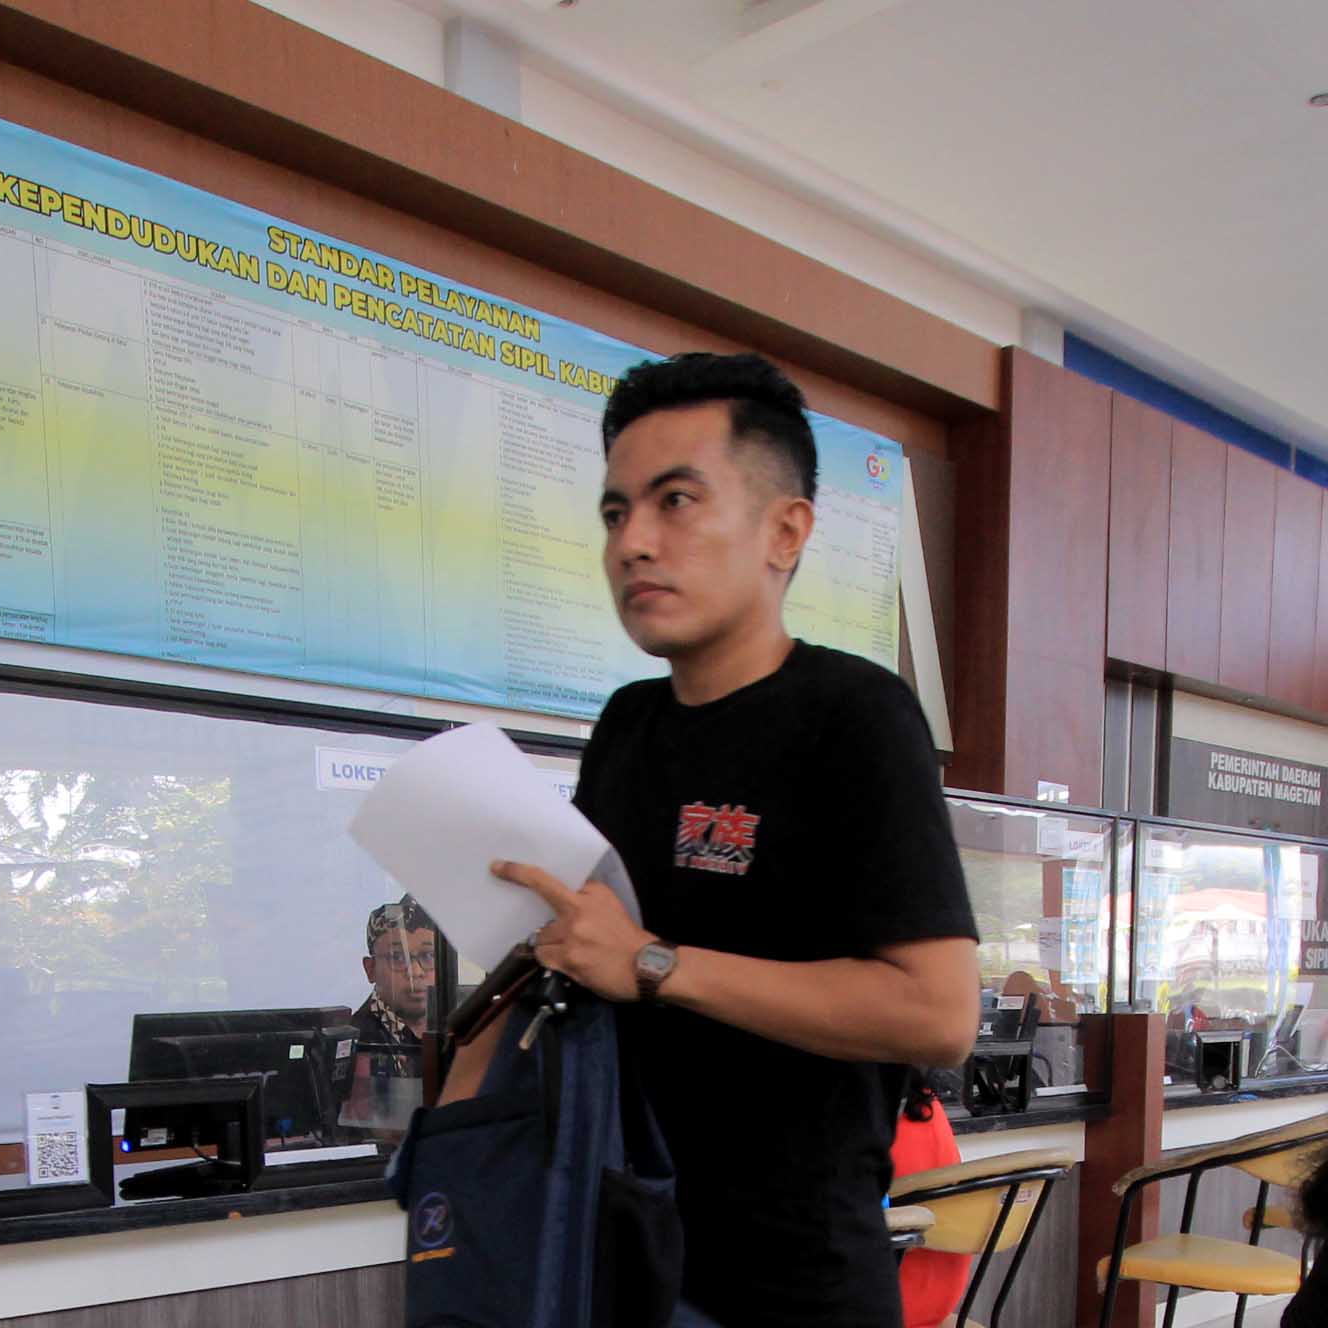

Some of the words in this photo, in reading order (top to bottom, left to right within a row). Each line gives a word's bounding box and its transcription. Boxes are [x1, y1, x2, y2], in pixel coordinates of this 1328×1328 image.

[267, 225, 395, 293] STANDAR
[400, 271, 541, 342] PELAYANAN
[267, 261, 328, 306] DAN
[333, 284, 496, 361] PENCATATAN
[500, 341, 555, 380] SIPIL
[331, 761, 387, 782] LOKET
[1210, 751, 1280, 780] PEMERINTAH
[1282, 765, 1322, 788] DAERAH
[1207, 771, 1273, 798] KABUPATEN
[1274, 782, 1322, 807] MAGETAN
